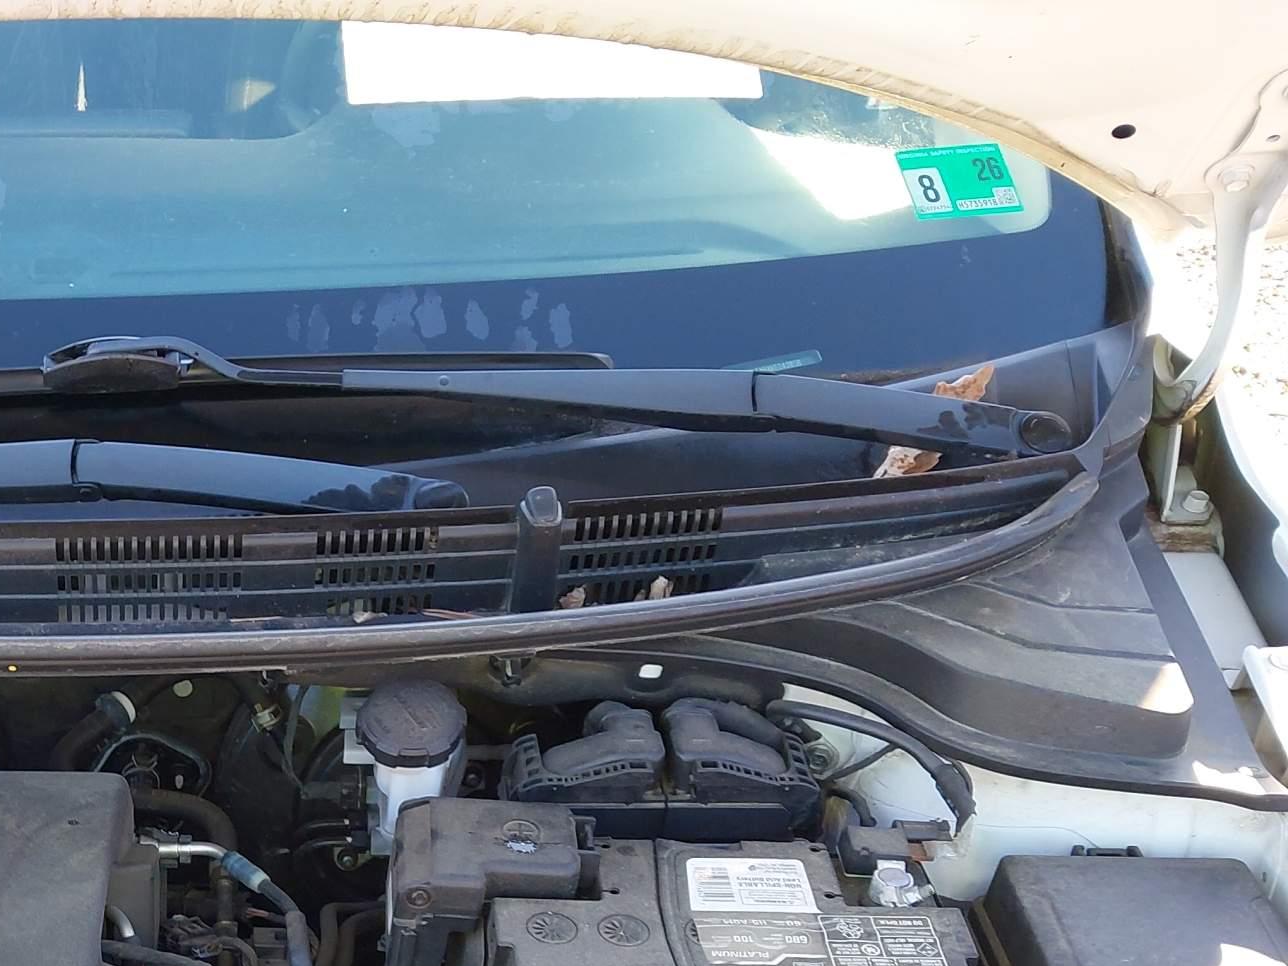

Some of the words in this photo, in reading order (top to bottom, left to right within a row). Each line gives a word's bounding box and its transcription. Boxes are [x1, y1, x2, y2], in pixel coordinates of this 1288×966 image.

[971, 156, 1004, 182] 26
[917, 174, 941, 203] 8
[711, 950, 770, 958] PLATINUM
